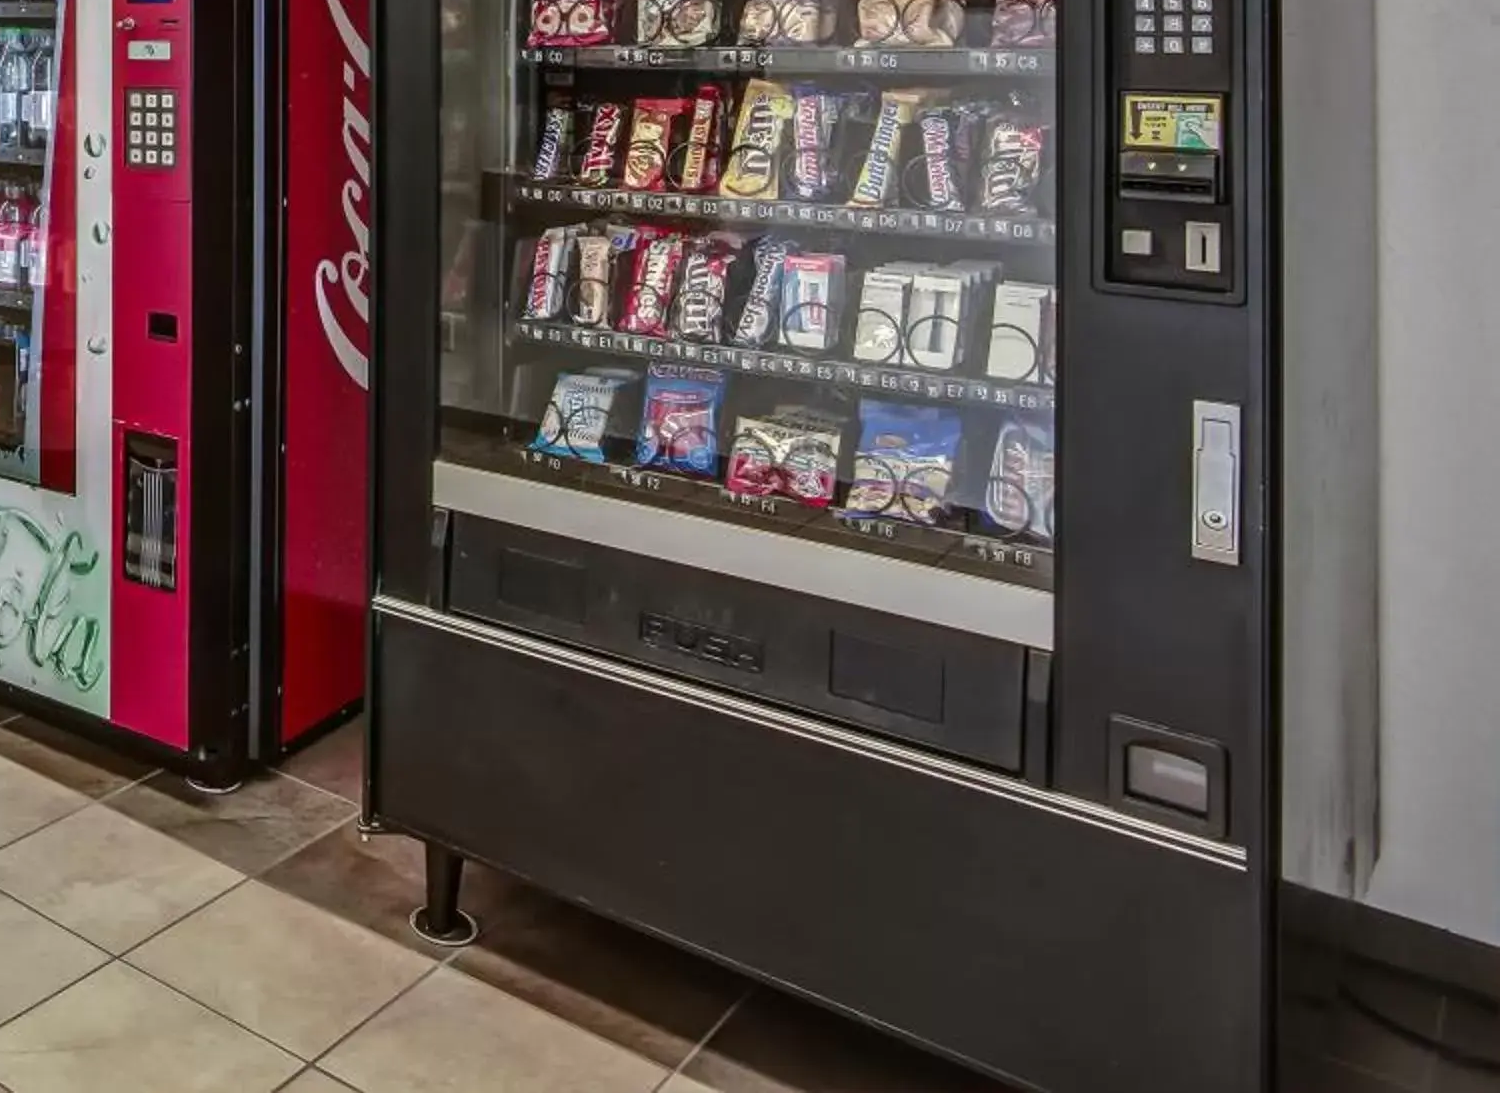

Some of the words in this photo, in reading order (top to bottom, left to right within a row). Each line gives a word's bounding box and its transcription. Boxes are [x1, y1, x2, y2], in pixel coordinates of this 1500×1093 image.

[856, 101, 900, 200] Butterfinger
[879, 214, 897, 226] D6
[945, 219, 962, 232] D7
